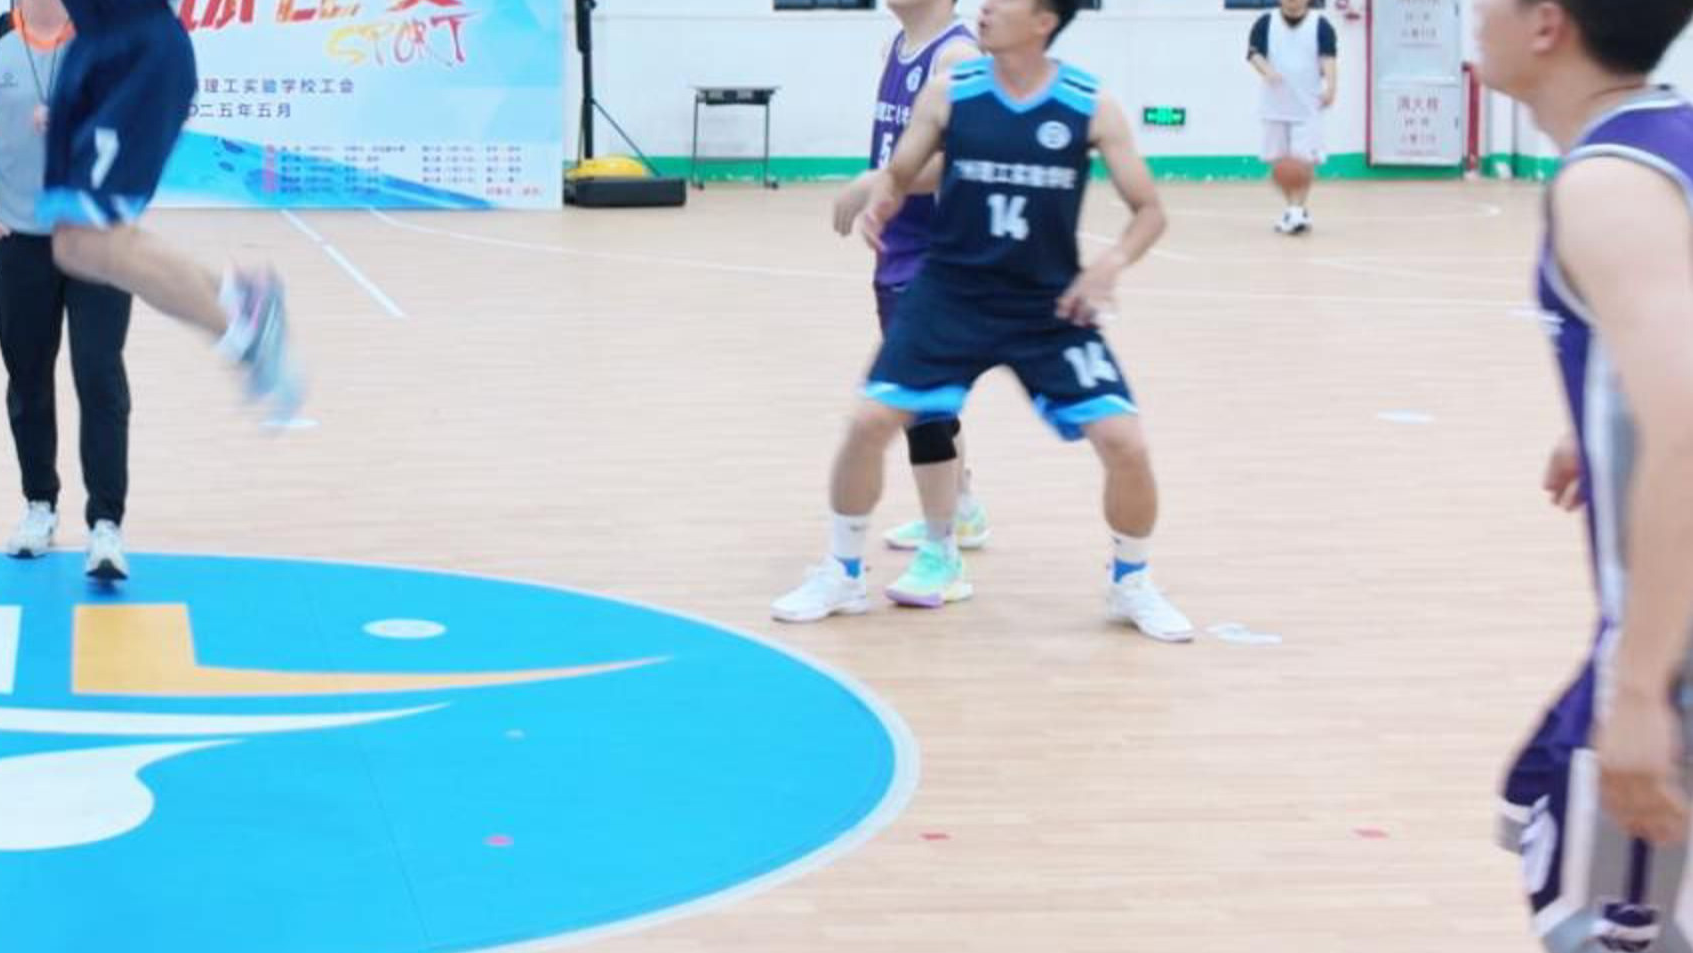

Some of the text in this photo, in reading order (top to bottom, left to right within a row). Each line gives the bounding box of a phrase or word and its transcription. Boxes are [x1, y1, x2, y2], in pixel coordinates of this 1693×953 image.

[195, 77, 355, 95] 理工实验学校工会
[986, 193, 1030, 241] 14
[1062, 342, 1118, 388] 14
